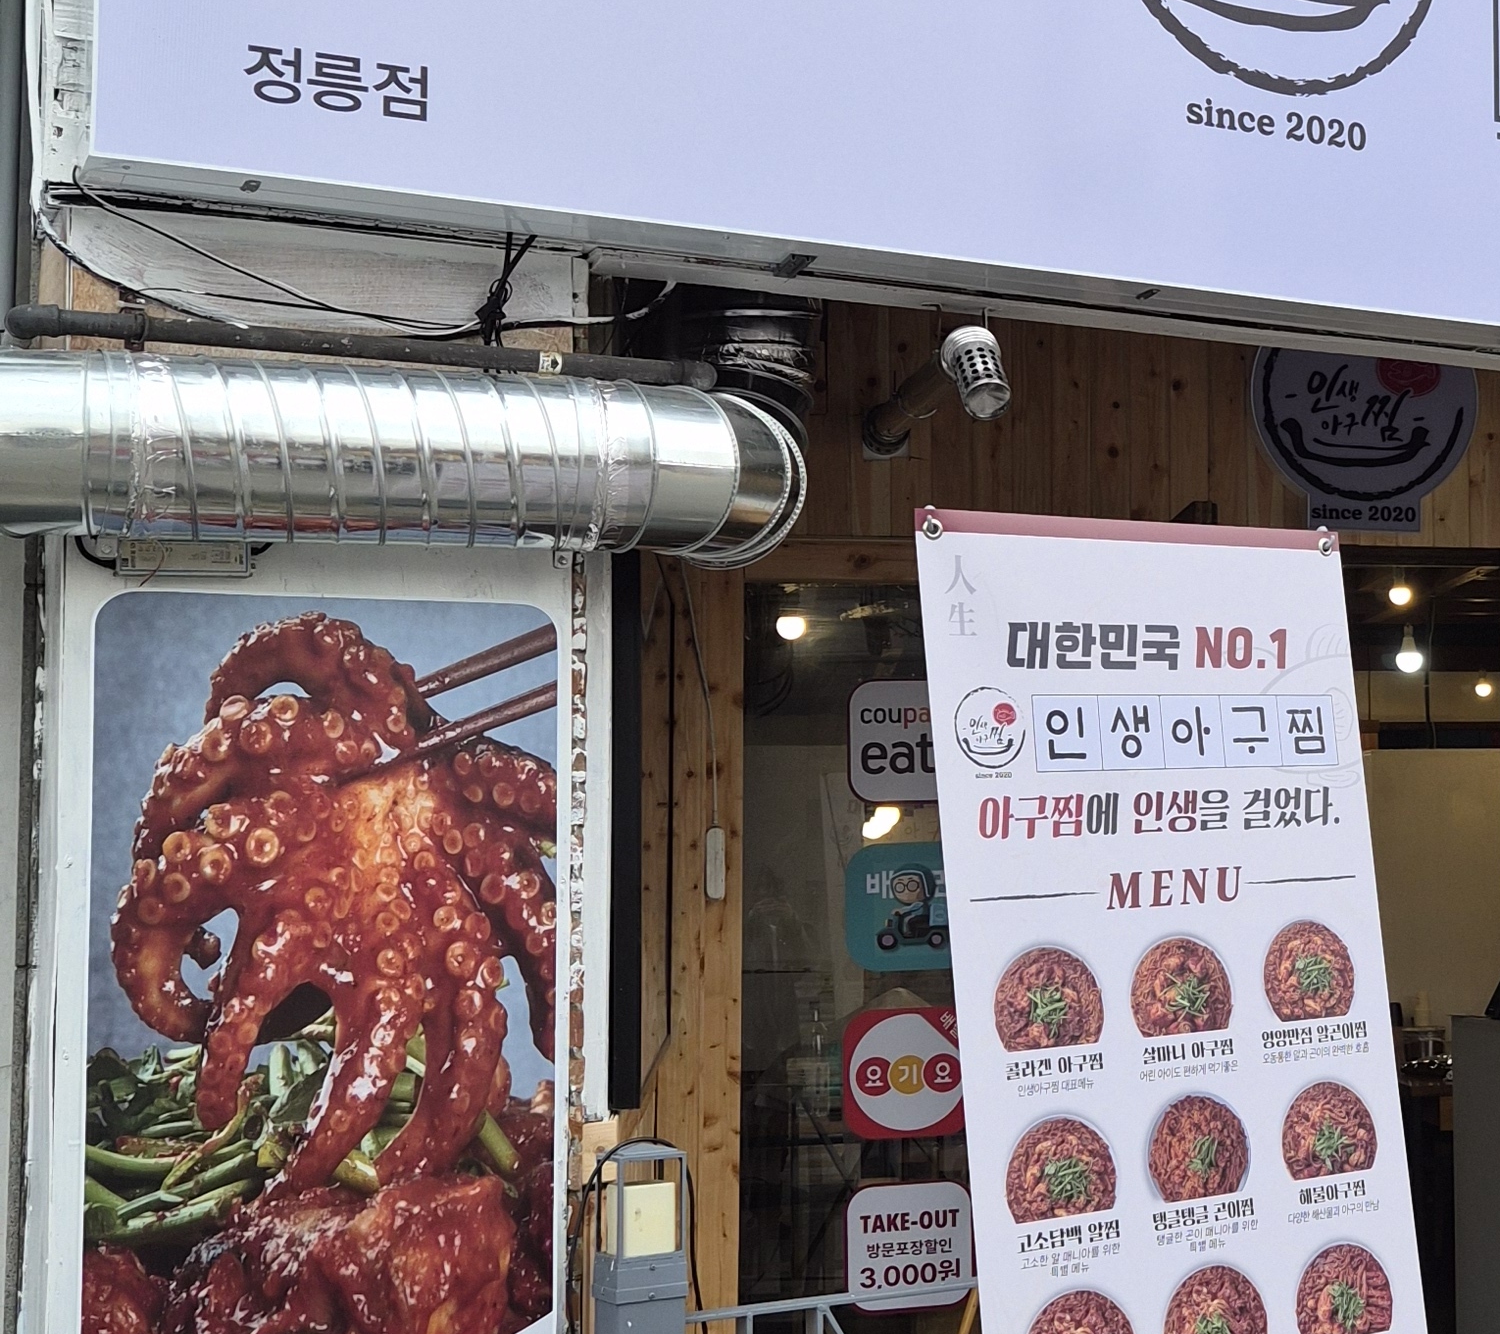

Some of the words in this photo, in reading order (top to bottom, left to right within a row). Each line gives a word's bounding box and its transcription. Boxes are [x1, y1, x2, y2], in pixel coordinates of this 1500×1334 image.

[243, 43, 431, 122] 정릉점
[1186, 98, 1275, 136] since
[1286, 112, 1367, 152] 2020
[1311, 505, 1363, 520] since
[1368, 505, 1416, 522] 2020
[1006, 620, 1181, 671] 대한민국
[1194, 626, 1288, 670] NO.1
[860, 707, 931, 729] coupa
[861, 733, 936, 775] eat
[977, 792, 1119, 840] 아구찜에
[1132, 788, 1230, 835] 인생을
[1242, 786, 1341, 831] 걸었다.
[1106, 866, 1243, 910] MENU
[1191, 1038, 1234, 1059] 아구찜
[1261, 1026, 1313, 1049] 영양만점
[1316, 1020, 1368, 1043] 알곤이찜
[864, 1060, 953, 1087] 요기요
[1005, 1058, 1052, 1081] 콜라겐
[1058, 1052, 1104, 1073] 아구찜
[1298, 1179, 1366, 1205] 해물아구찜
[860, 1208, 960, 1234] TAKE-OUT
[1152, 1205, 1209, 1232] 탱글탱글
[1213, 1197, 1255, 1222] 곤이찜
[866, 1238, 952, 1259] 방문포장할인
[1016, 1225, 1082, 1254] 고소담백
[1088, 1219, 1120, 1242] 알찜
